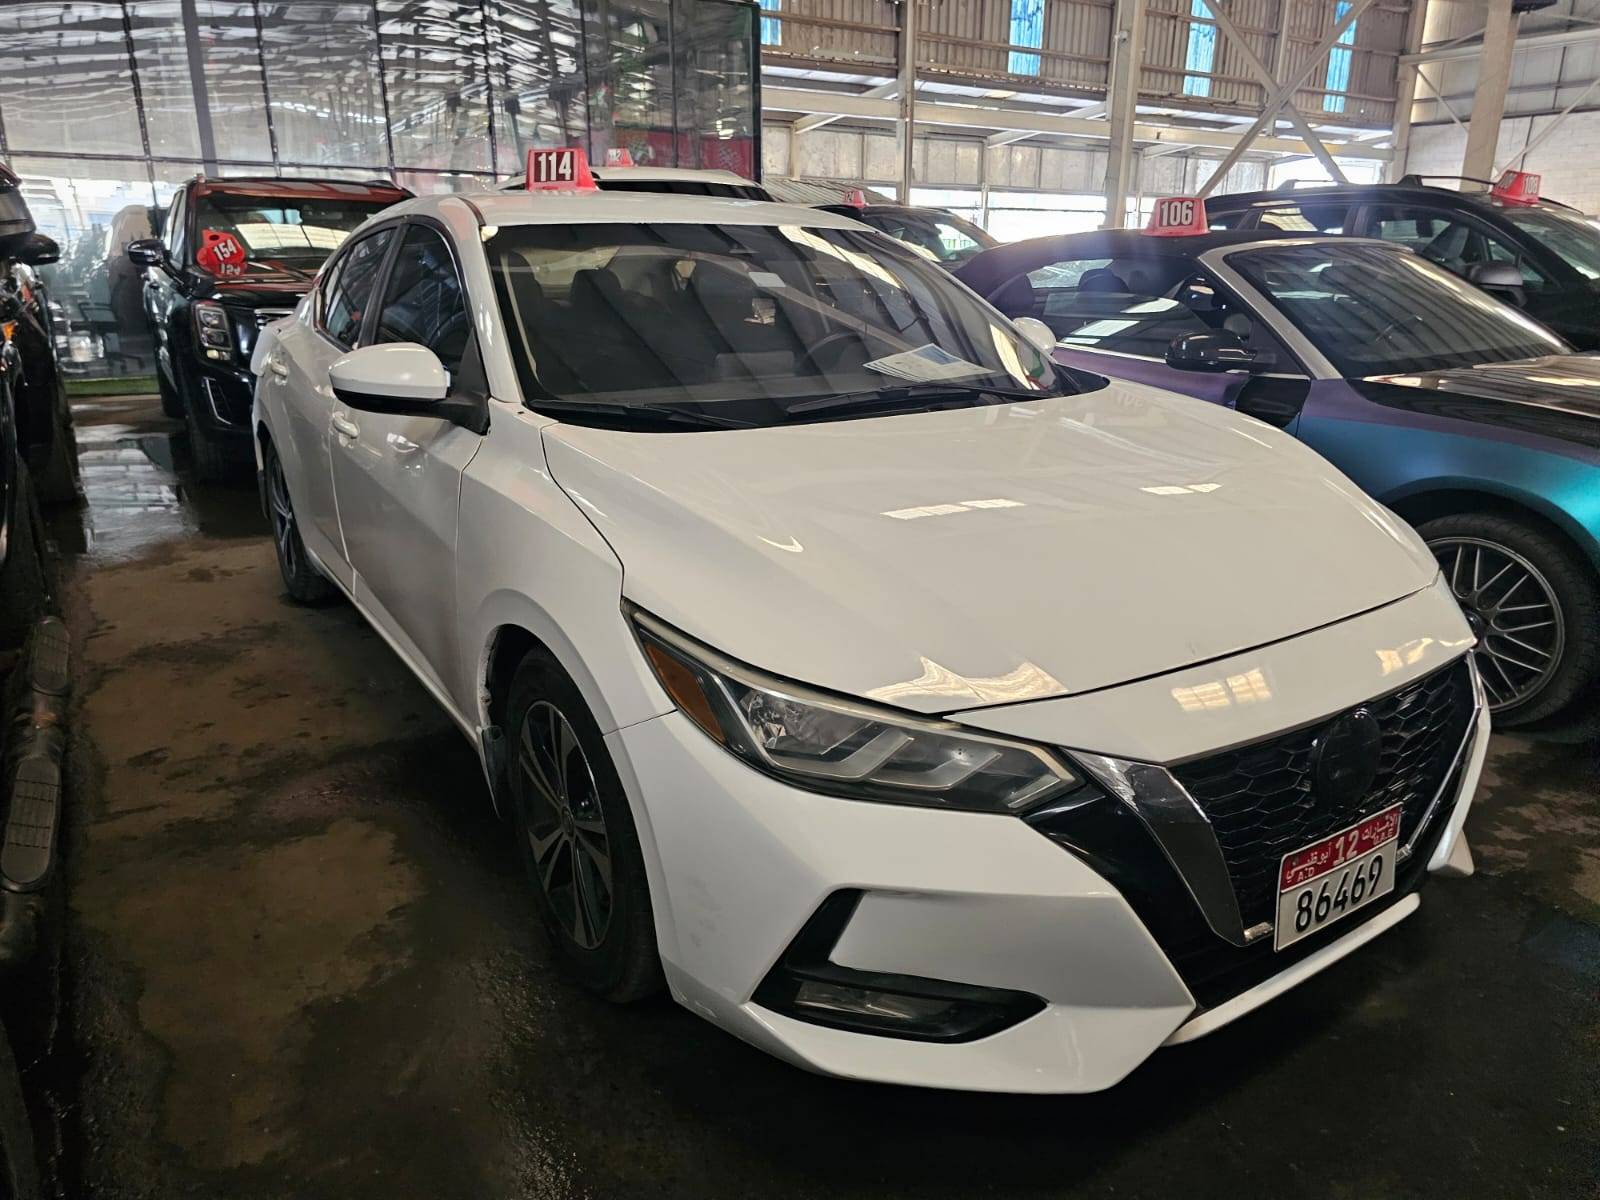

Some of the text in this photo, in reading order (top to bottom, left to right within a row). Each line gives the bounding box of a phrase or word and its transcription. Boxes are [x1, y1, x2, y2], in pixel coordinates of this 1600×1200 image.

[538, 151, 572, 182] 114
[1161, 200, 1194, 227] 106
[213, 238, 238, 261] 154
[1332, 829, 1360, 867] 12
[1294, 853, 1384, 933] 86469
